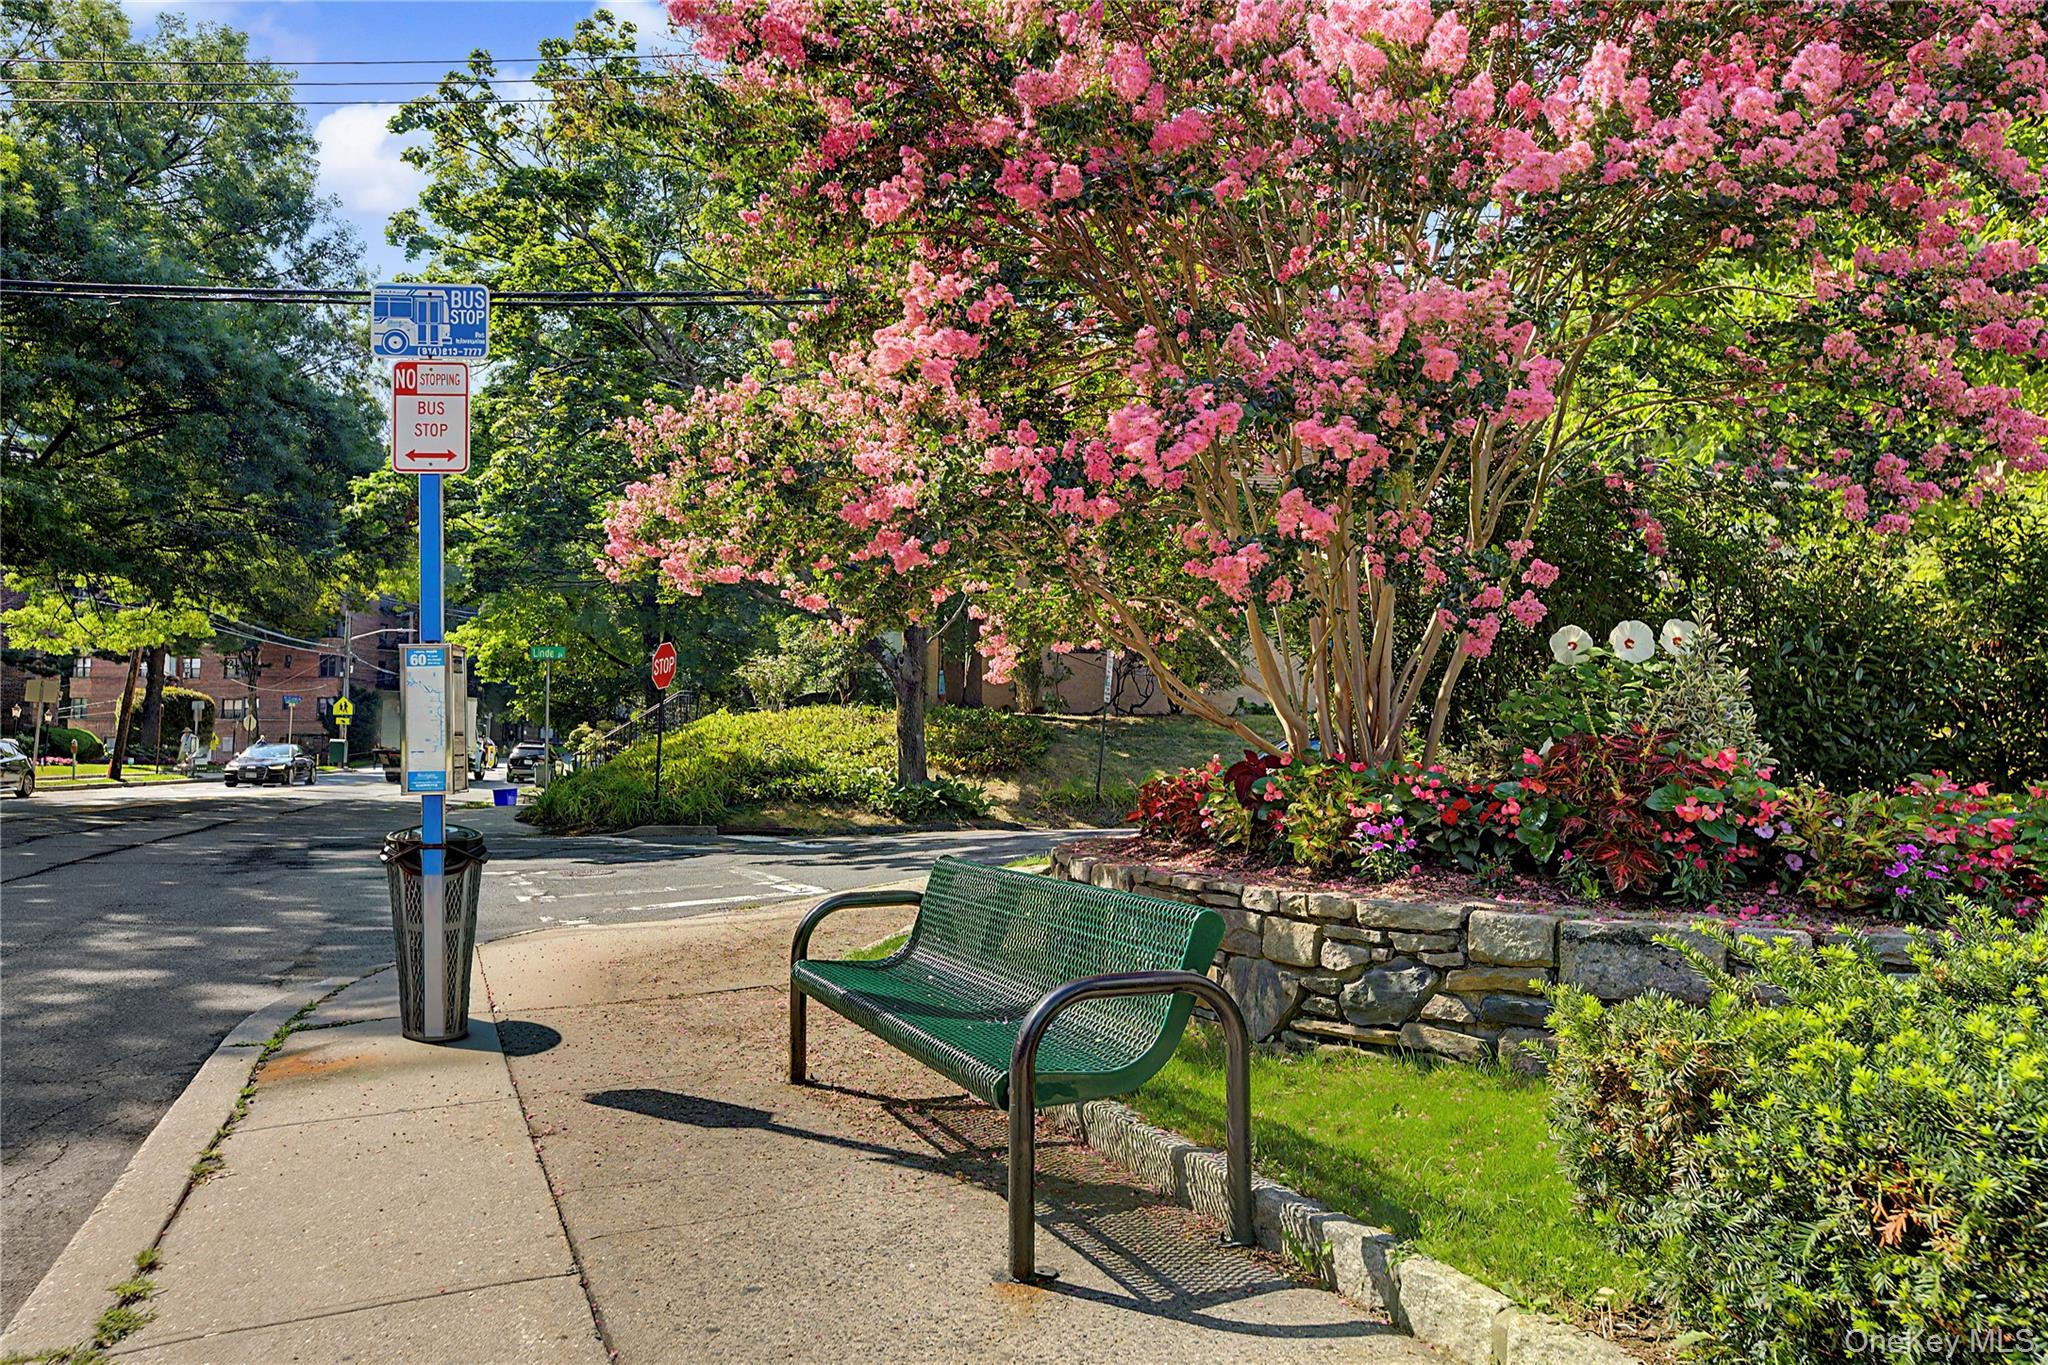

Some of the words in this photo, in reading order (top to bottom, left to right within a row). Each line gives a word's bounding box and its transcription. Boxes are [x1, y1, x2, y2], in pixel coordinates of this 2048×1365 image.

[451, 290, 485, 309] BUS
[450, 309, 485, 325] STOP
[395, 368, 417, 389] NO
[419, 373, 460, 386] STOPPING
[417, 401, 445, 415] BUS
[414, 423, 448, 437] STOP
[410, 653, 427, 666] 60
[533, 648, 555, 658] Linde
[653, 656, 675, 676] STOP
